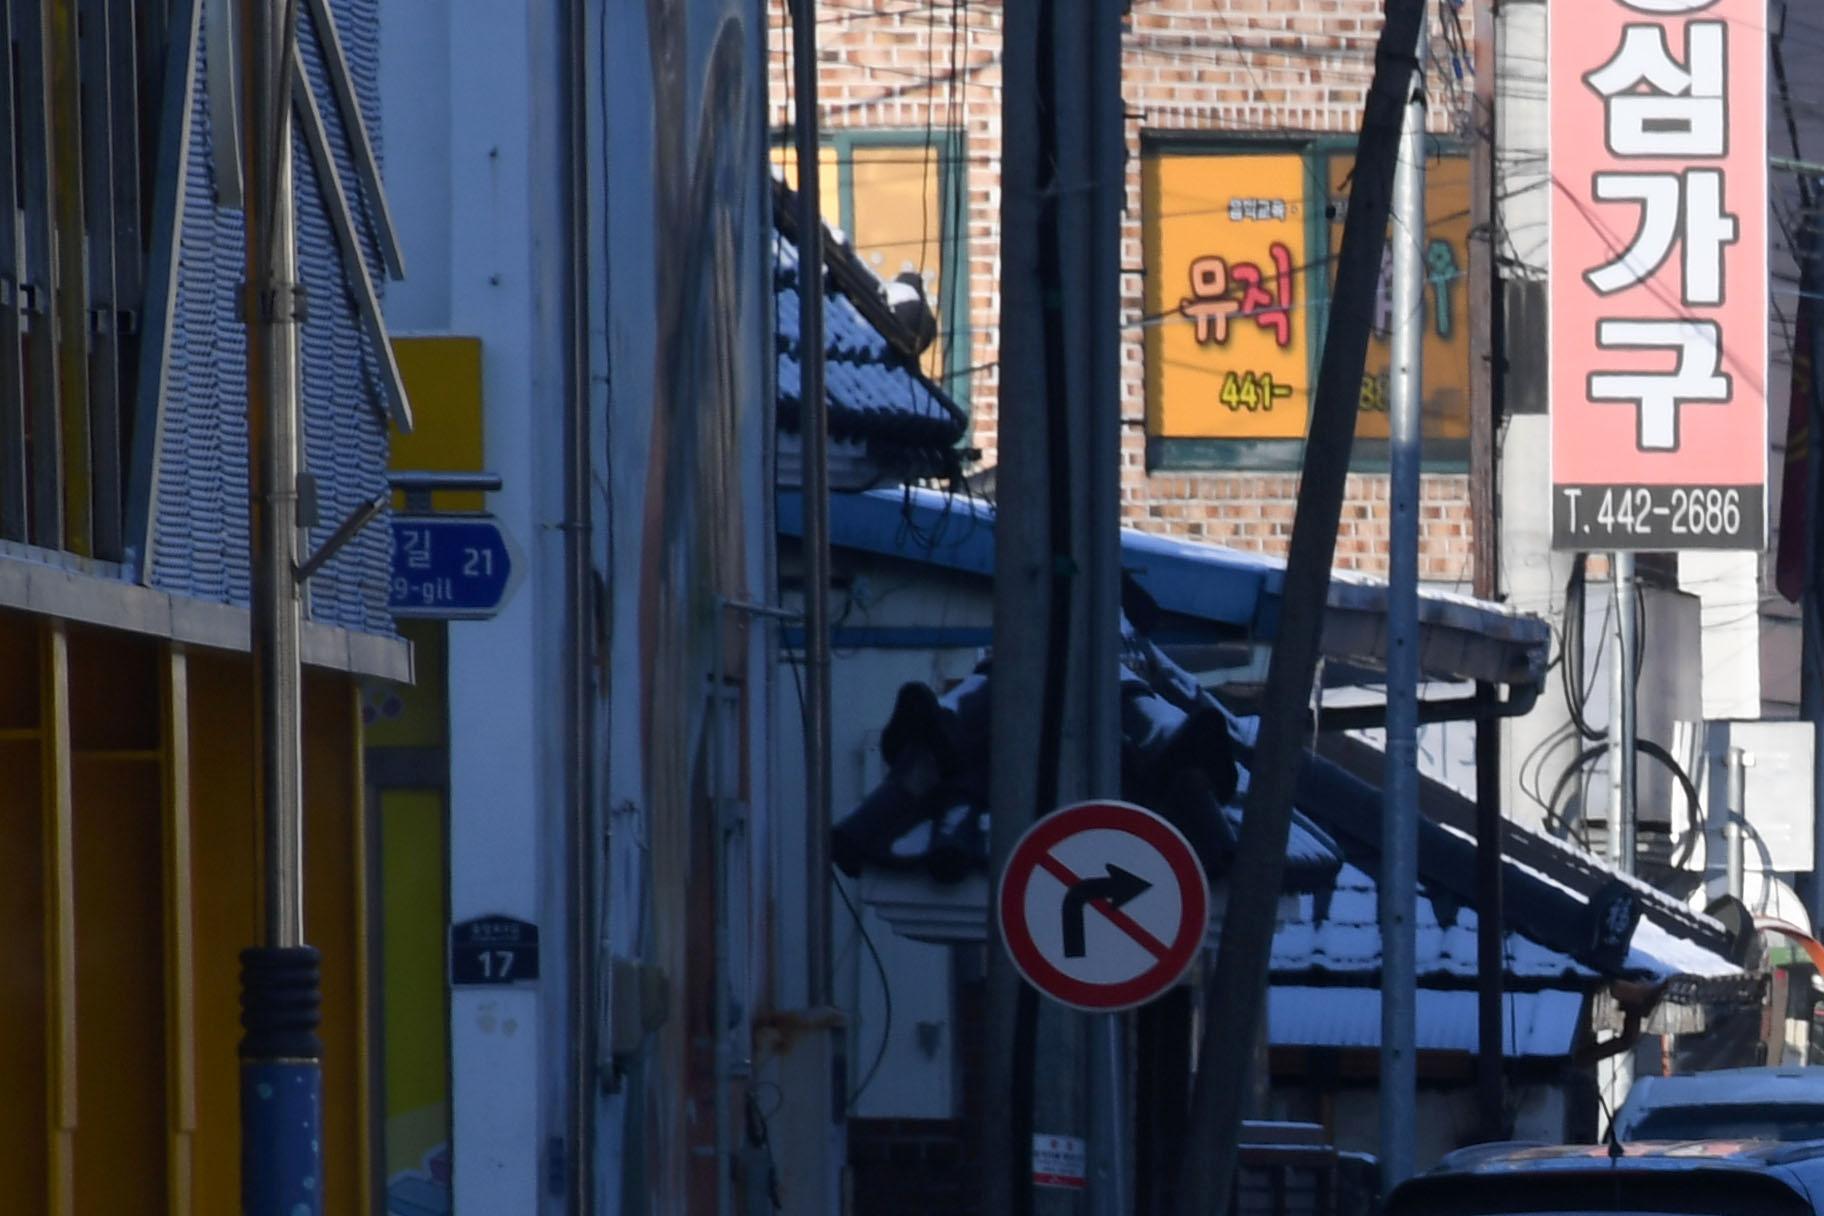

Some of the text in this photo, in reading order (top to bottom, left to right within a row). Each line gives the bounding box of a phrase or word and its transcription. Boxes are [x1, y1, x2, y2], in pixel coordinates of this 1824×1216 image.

[1581, 0, 1740, 452] 심가구
[1563, 488, 1740, 534] T.442-2686
[463, 548, 492, 576] 21
[478, 951, 514, 977] 17
